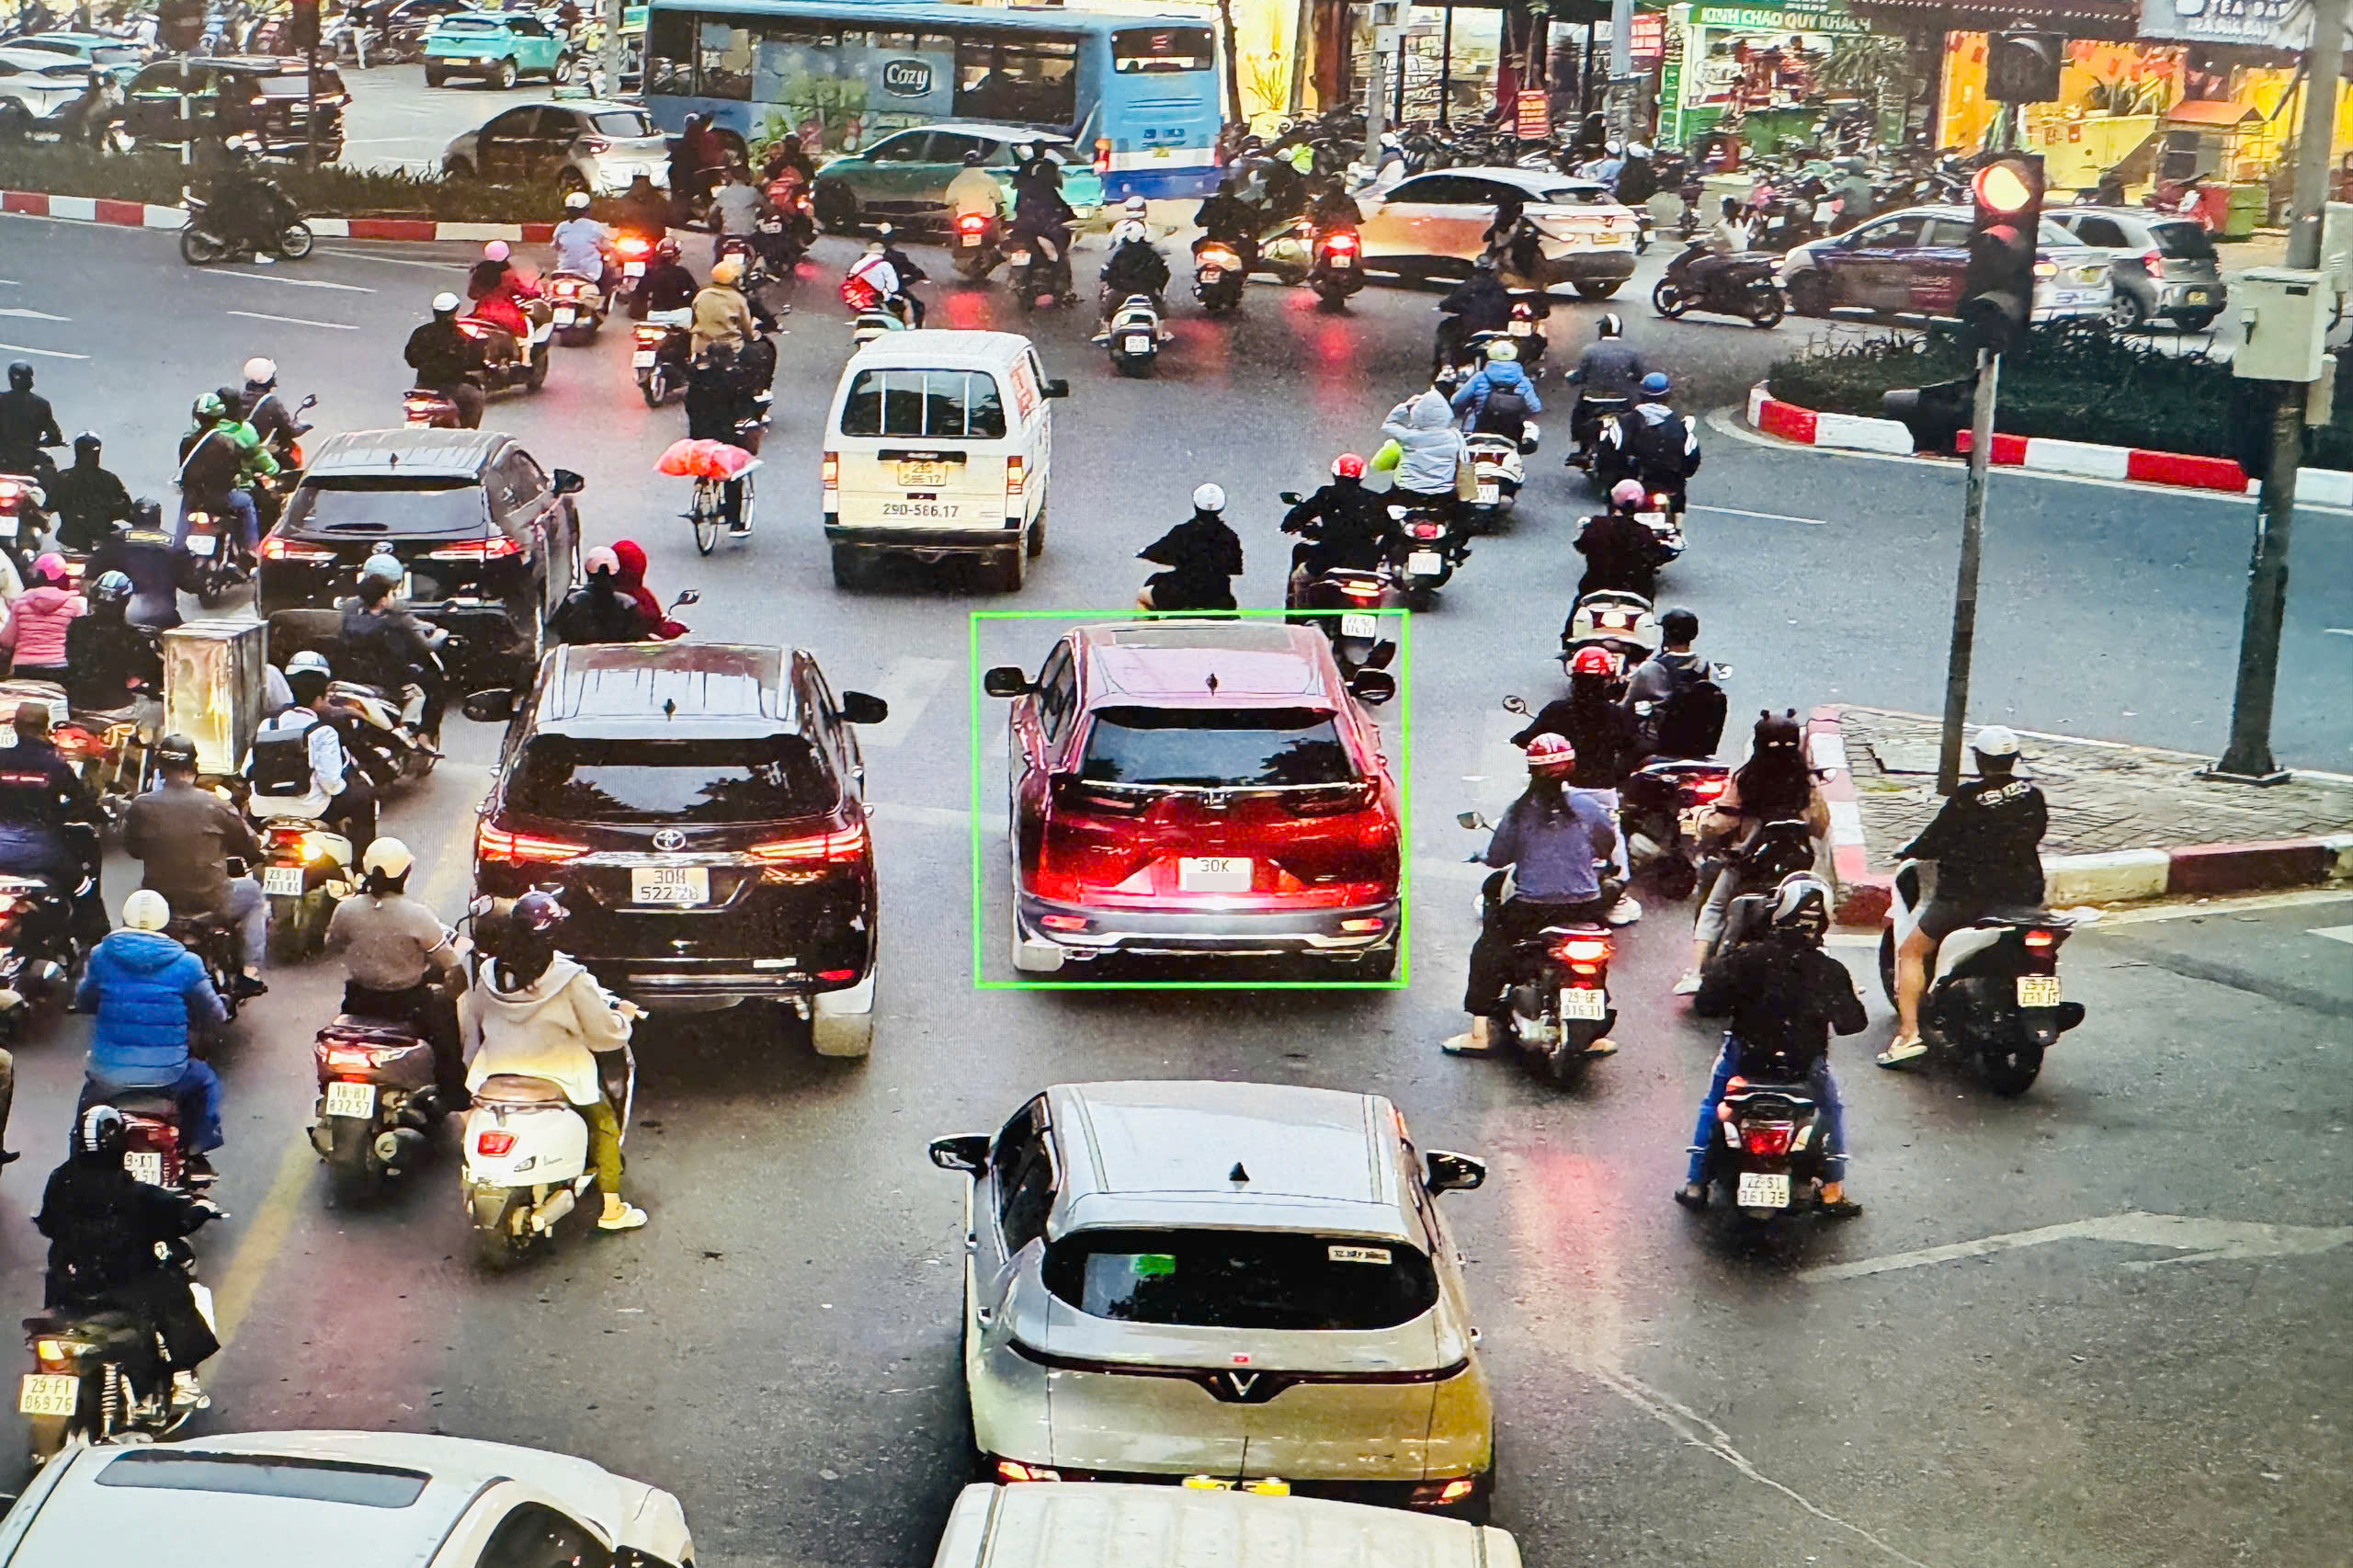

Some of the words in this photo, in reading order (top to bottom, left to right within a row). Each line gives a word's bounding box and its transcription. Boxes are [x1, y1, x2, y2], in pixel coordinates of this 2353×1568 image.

[887, 63, 927, 90] Cozy
[883, 503, 959, 517] 29D-586.17
[1200, 859, 1229, 872] 30K
